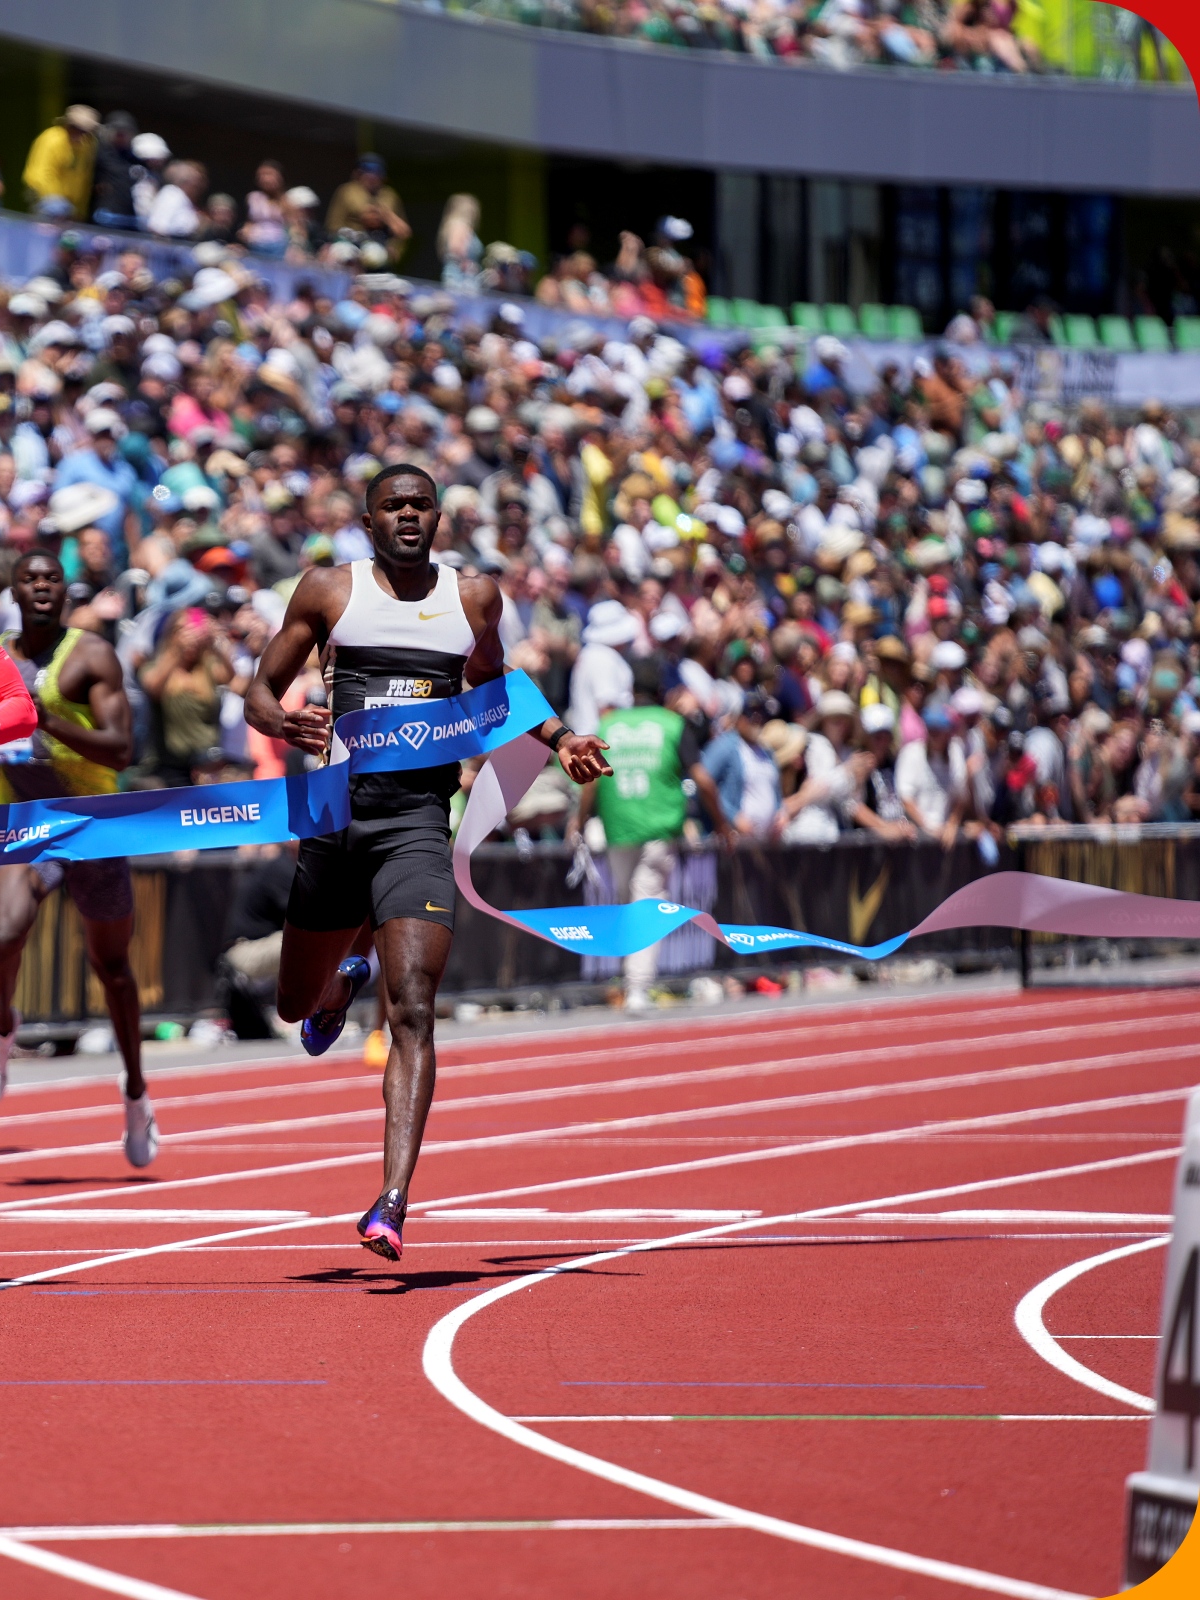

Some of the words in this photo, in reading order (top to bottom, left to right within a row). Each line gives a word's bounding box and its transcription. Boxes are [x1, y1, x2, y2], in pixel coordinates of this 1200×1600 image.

[432, 715, 478, 741] DIAMOND
[477, 703, 510, 728] LEAGUE
[180, 803, 261, 827] EUGENE
[549, 925, 594, 940] EUGENE
